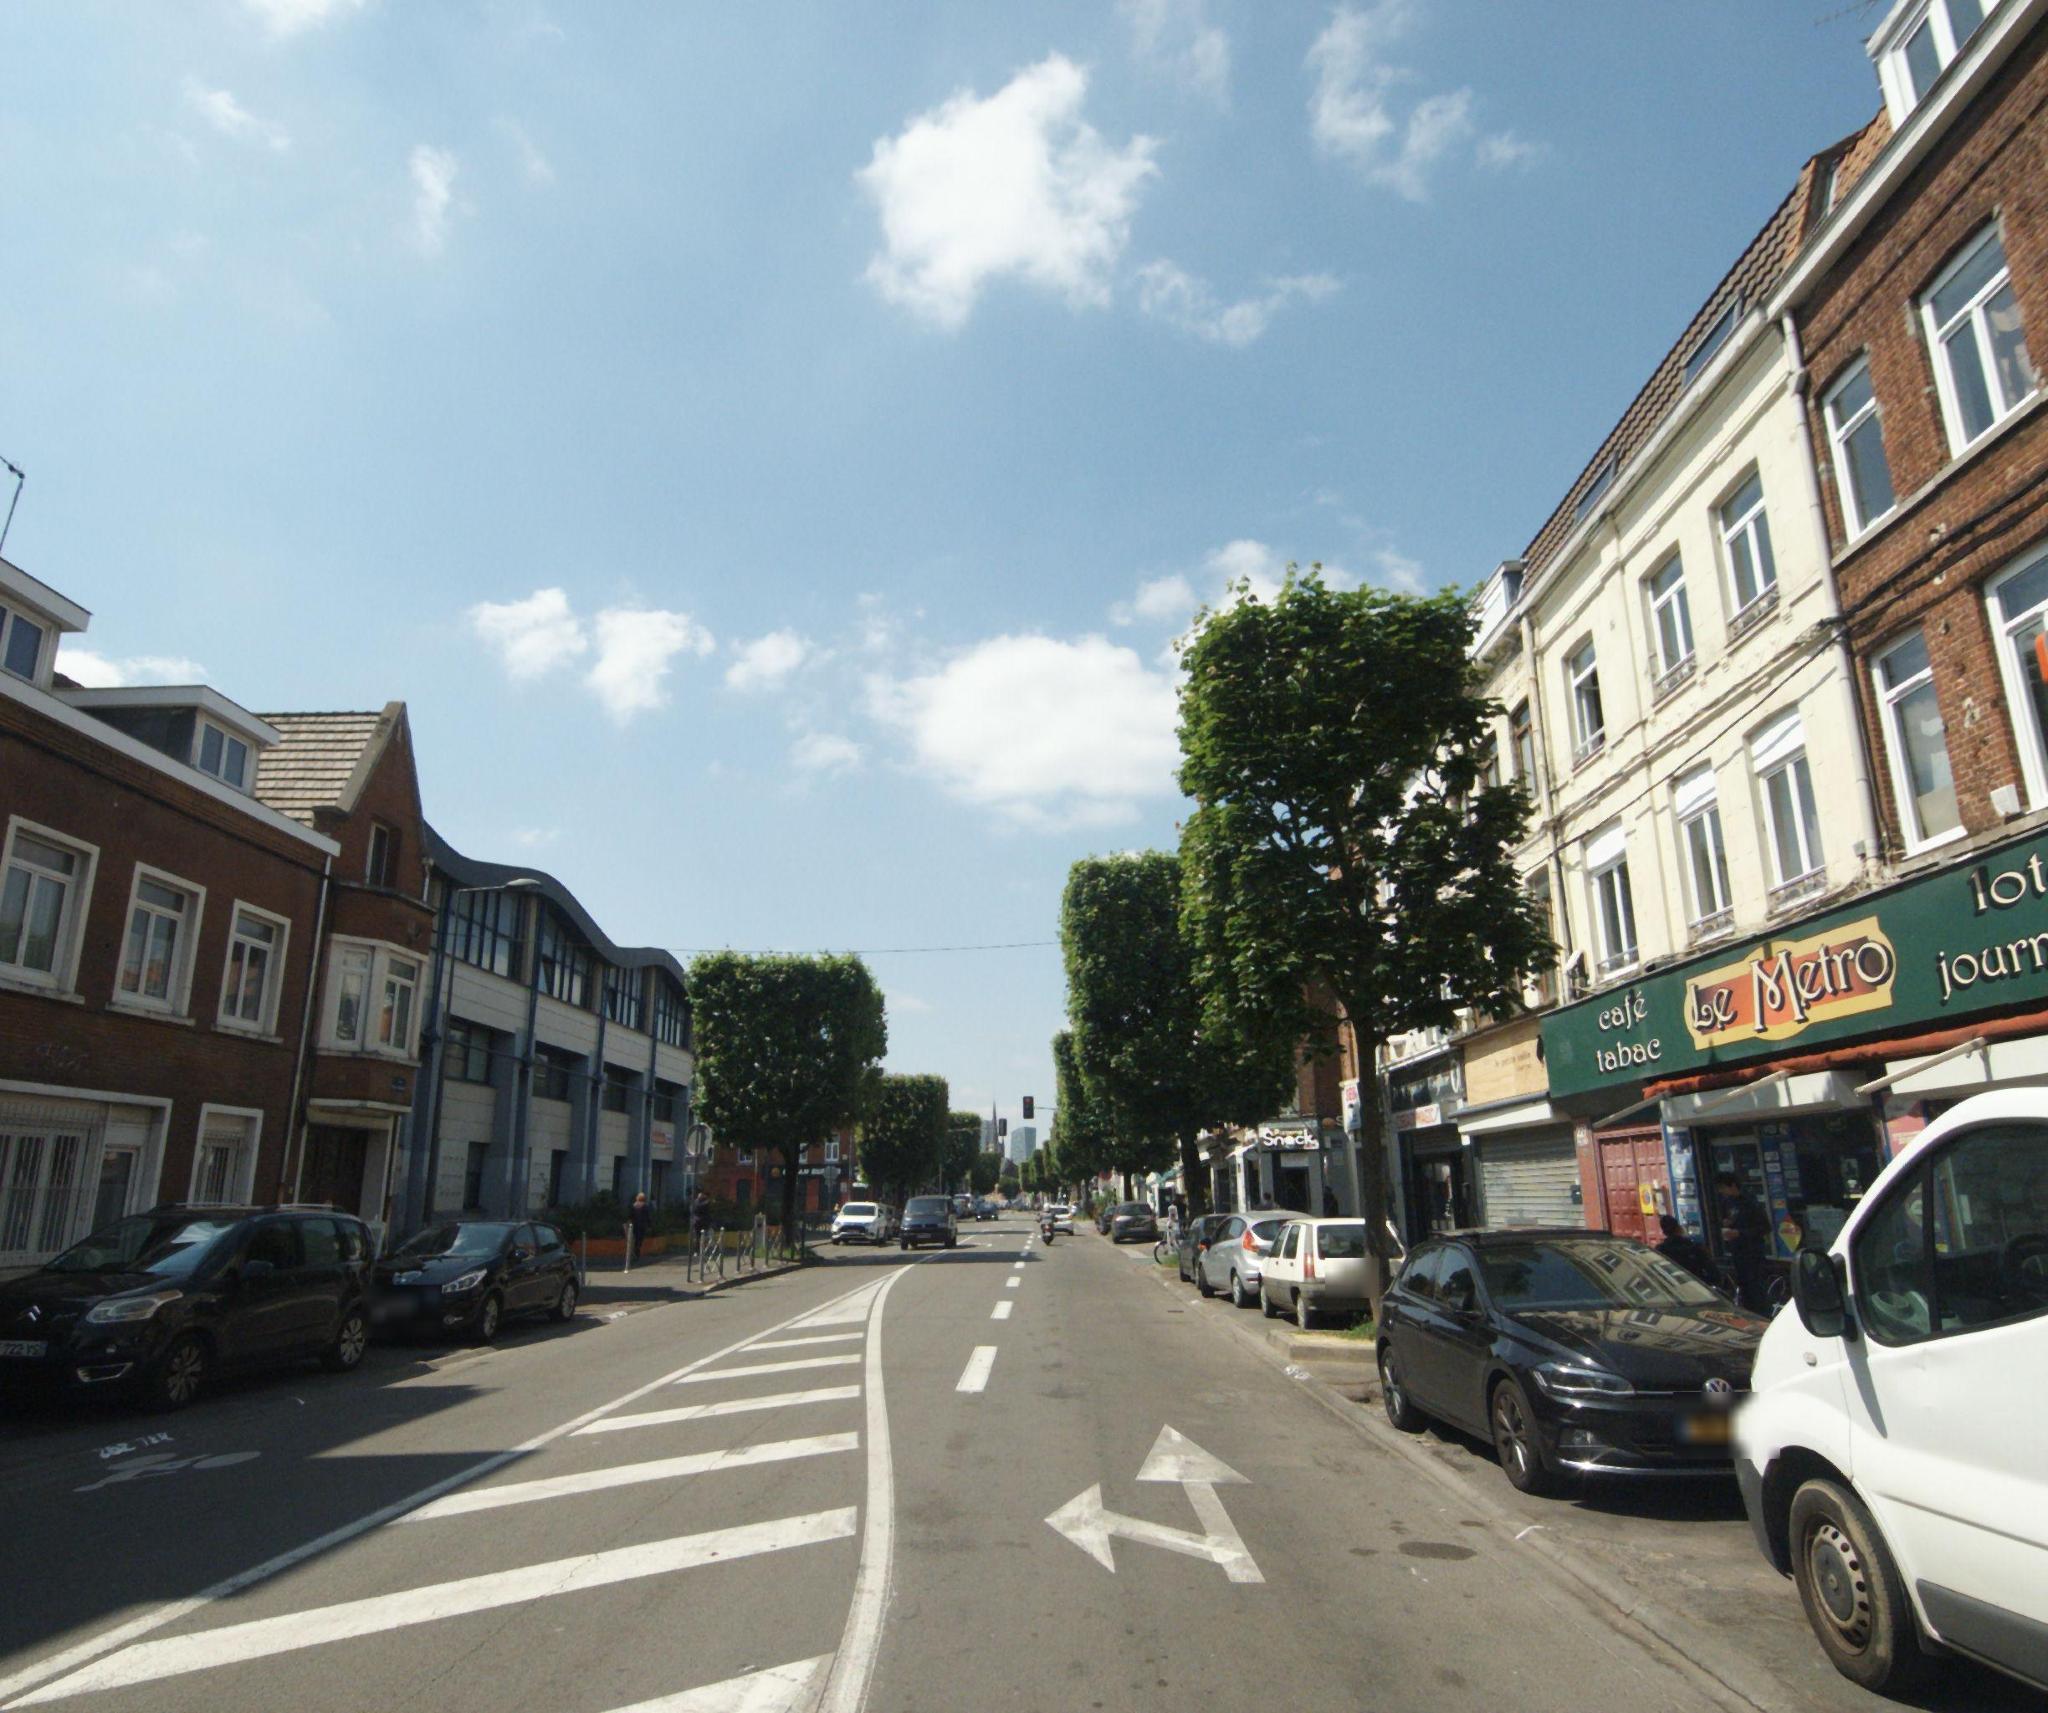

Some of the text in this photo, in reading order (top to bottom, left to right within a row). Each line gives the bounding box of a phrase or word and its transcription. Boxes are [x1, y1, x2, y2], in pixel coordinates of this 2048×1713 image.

[1691, 941, 1889, 1031] Le Metro
[1598, 991, 1649, 1031] café
[1596, 1038, 1661, 1072] tabac
